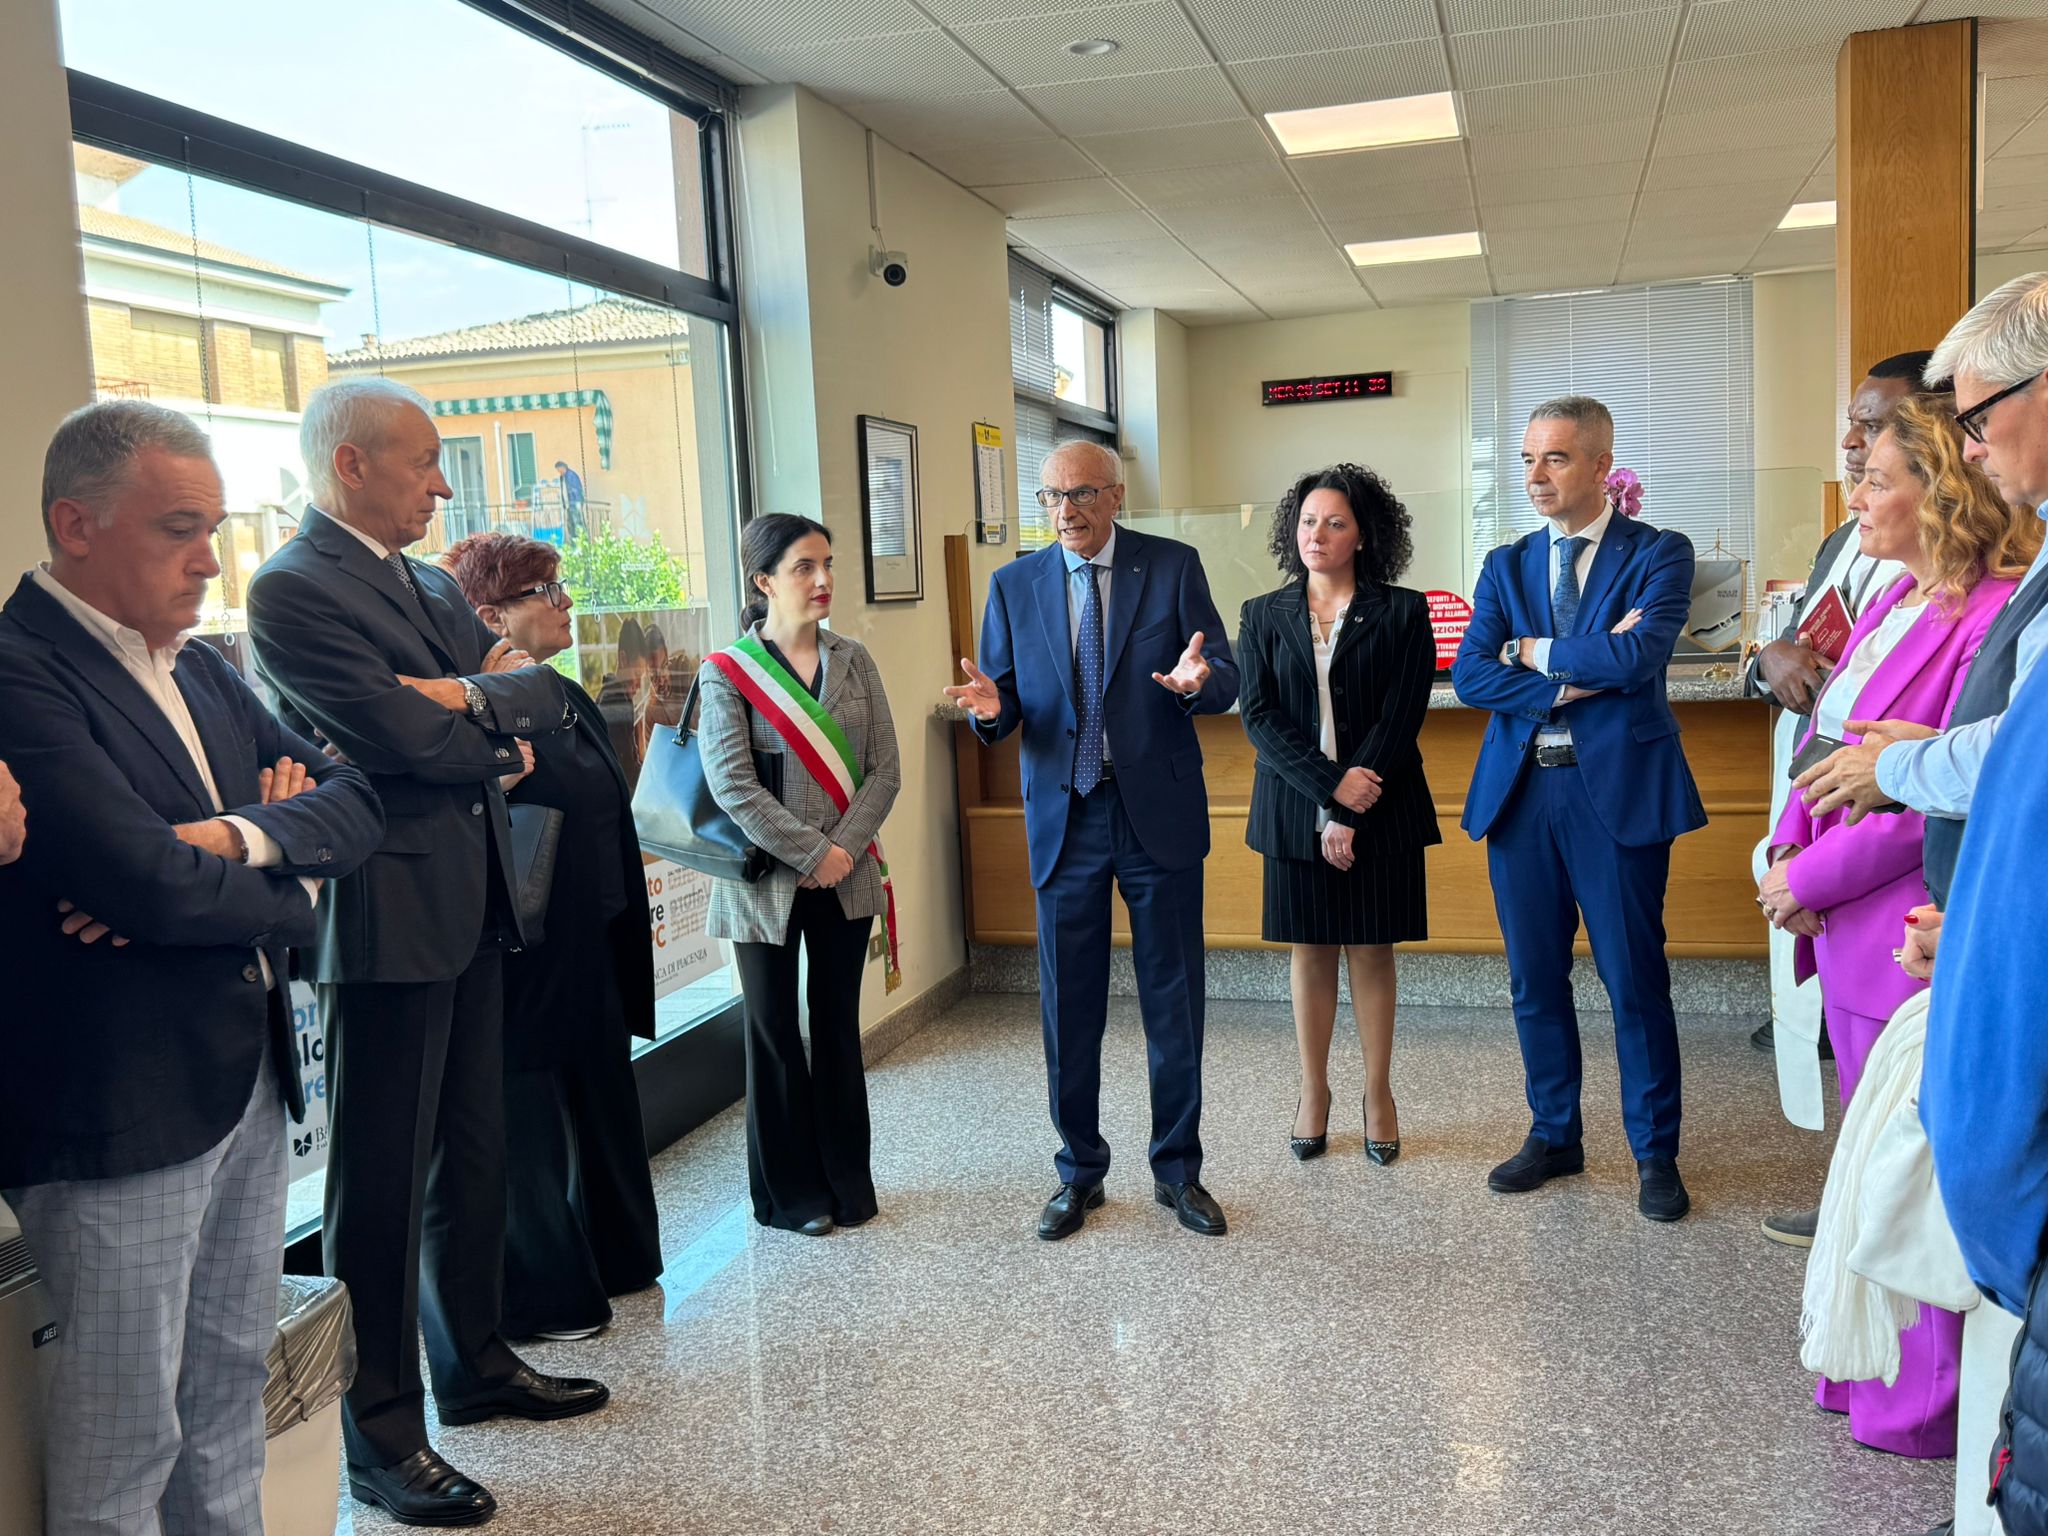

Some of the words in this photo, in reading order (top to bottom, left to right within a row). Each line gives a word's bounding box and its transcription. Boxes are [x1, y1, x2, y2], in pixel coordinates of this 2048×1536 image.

[1268, 385, 1294, 399] MER
[1316, 381, 1341, 395] SET
[1344, 380, 1359, 393] 11
